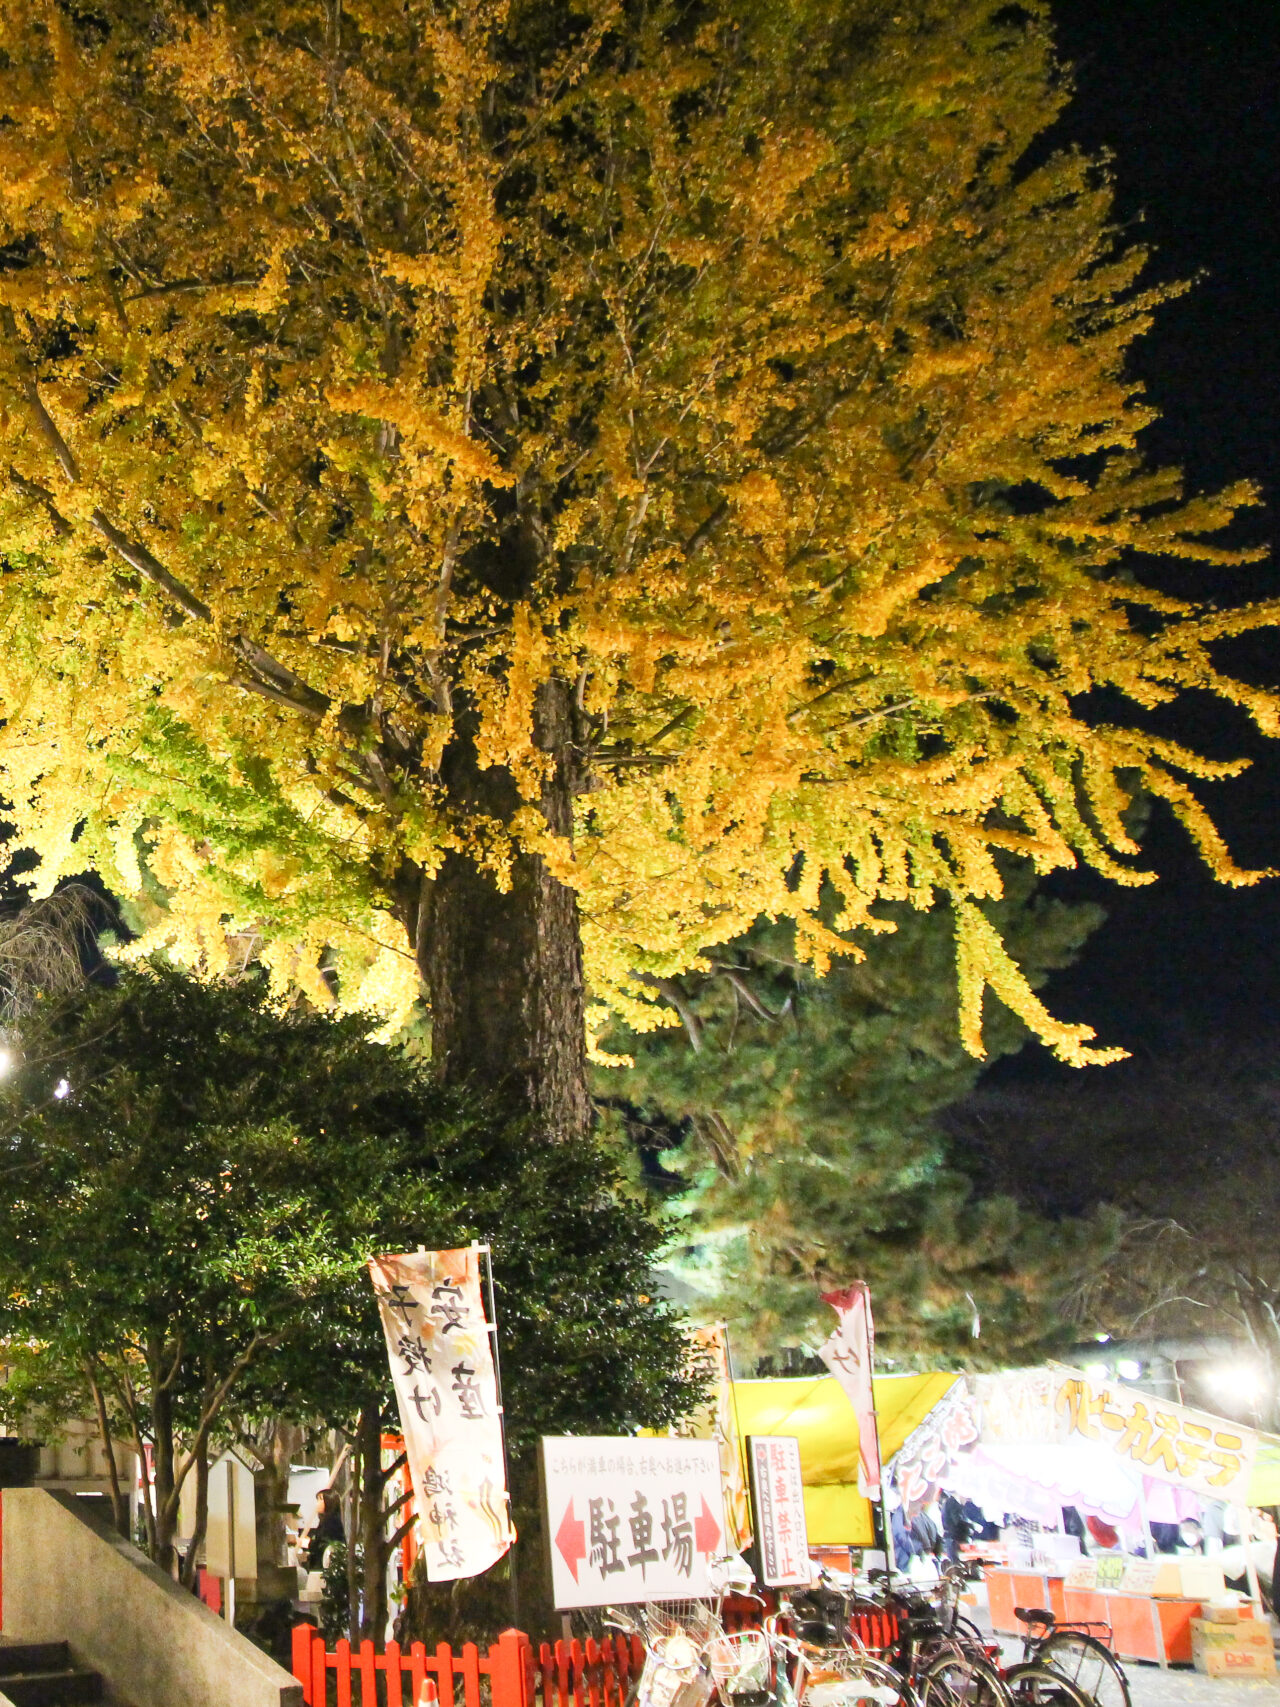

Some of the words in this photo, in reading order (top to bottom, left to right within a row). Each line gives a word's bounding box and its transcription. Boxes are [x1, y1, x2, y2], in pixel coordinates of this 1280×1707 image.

[1055, 1379, 1243, 1487] ベビーカステラ
[588, 1490, 694, 1584] 駐車場
[770, 1444, 796, 1578] 駐車禁止
[1224, 1651, 1255, 1666] Dole
